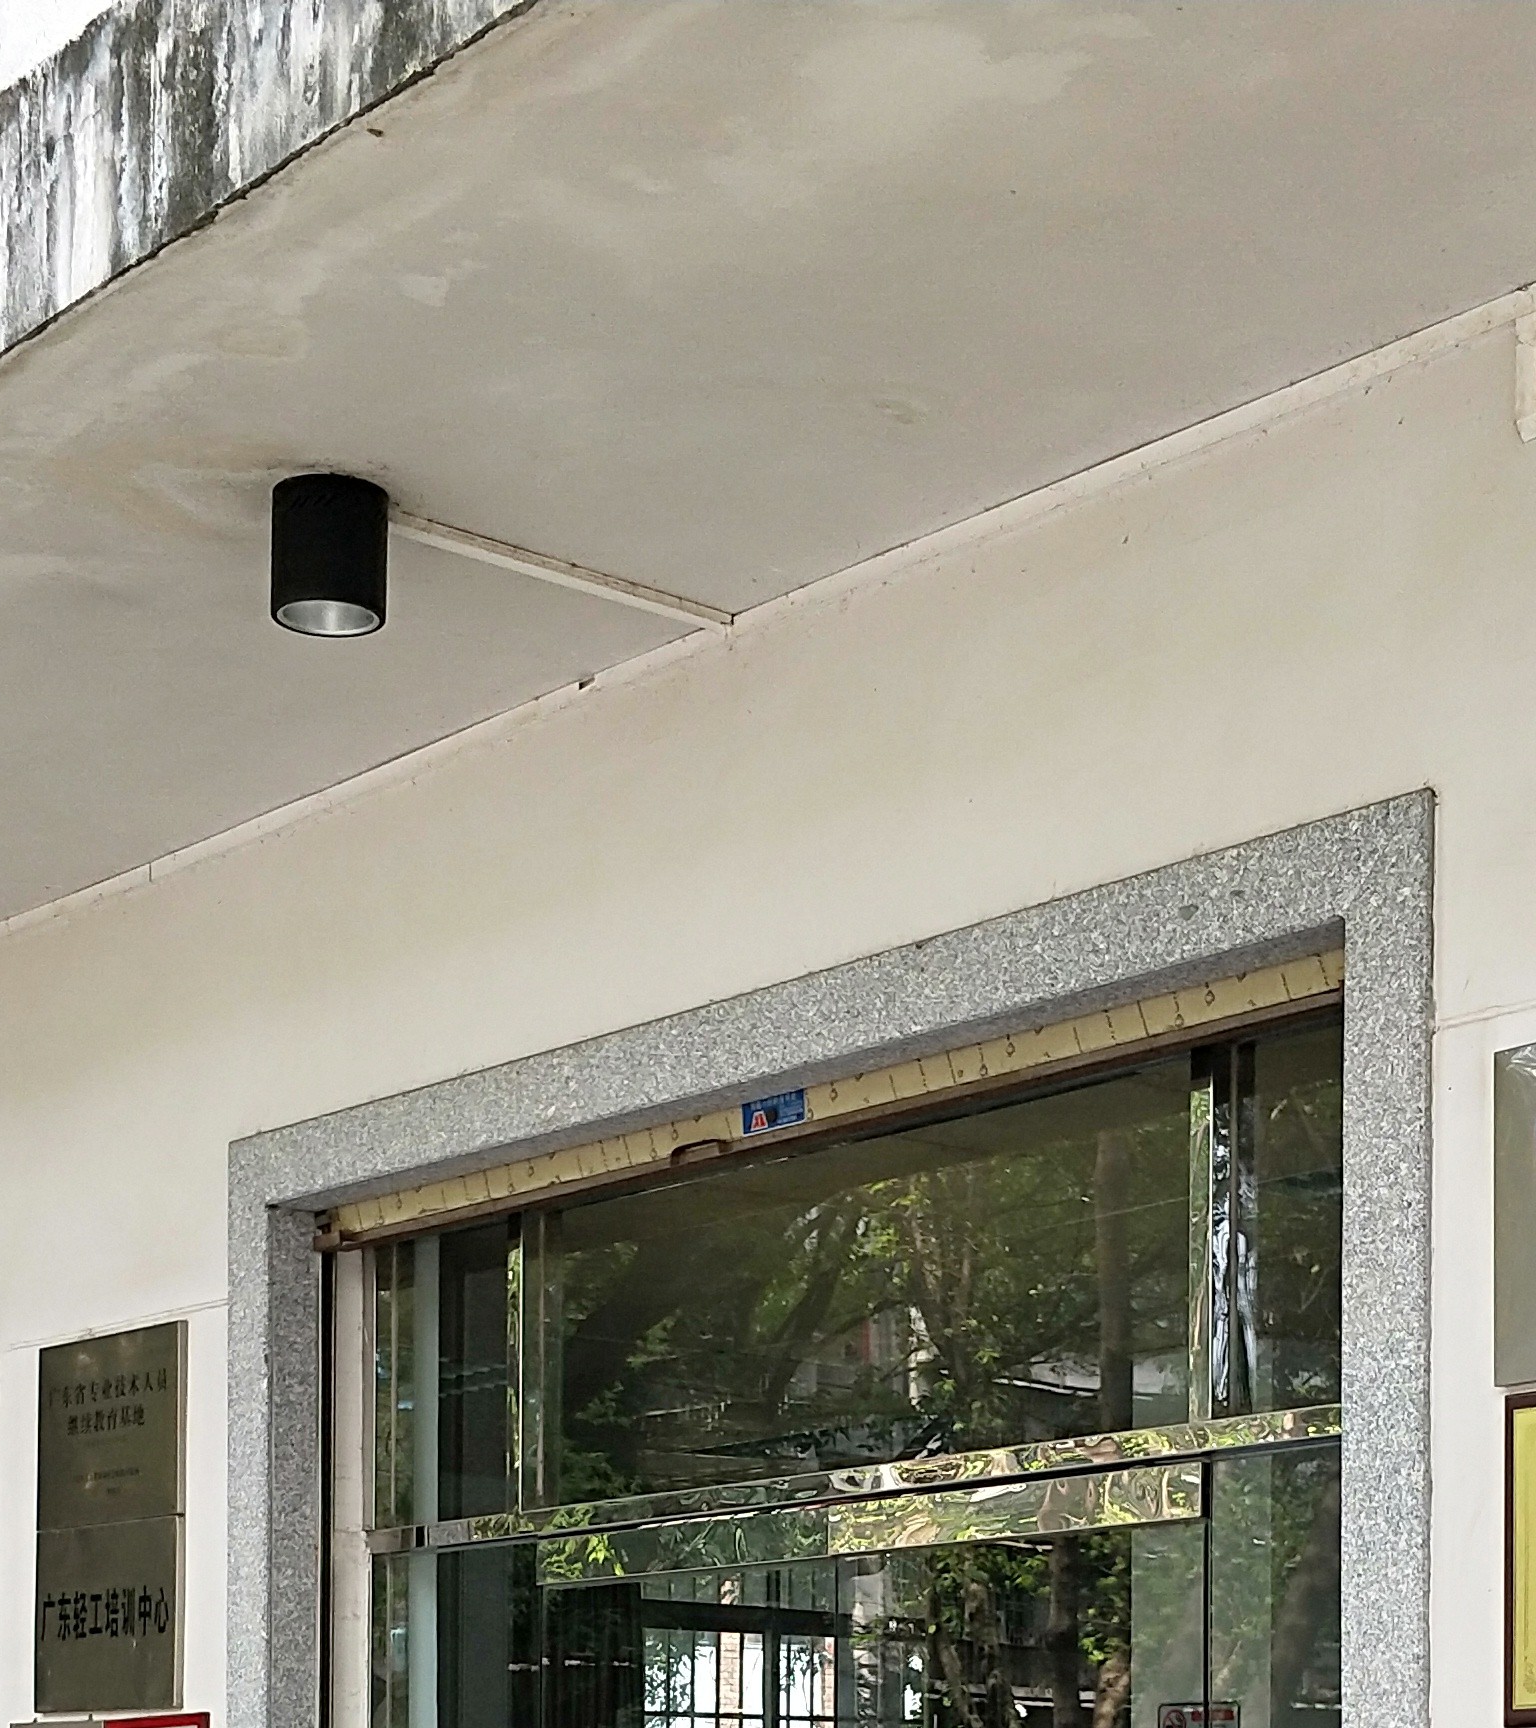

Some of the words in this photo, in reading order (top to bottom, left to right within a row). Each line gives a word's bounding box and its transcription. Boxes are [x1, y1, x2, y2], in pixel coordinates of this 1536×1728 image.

[41, 1585, 169, 1641] 广东轻工培训中心
